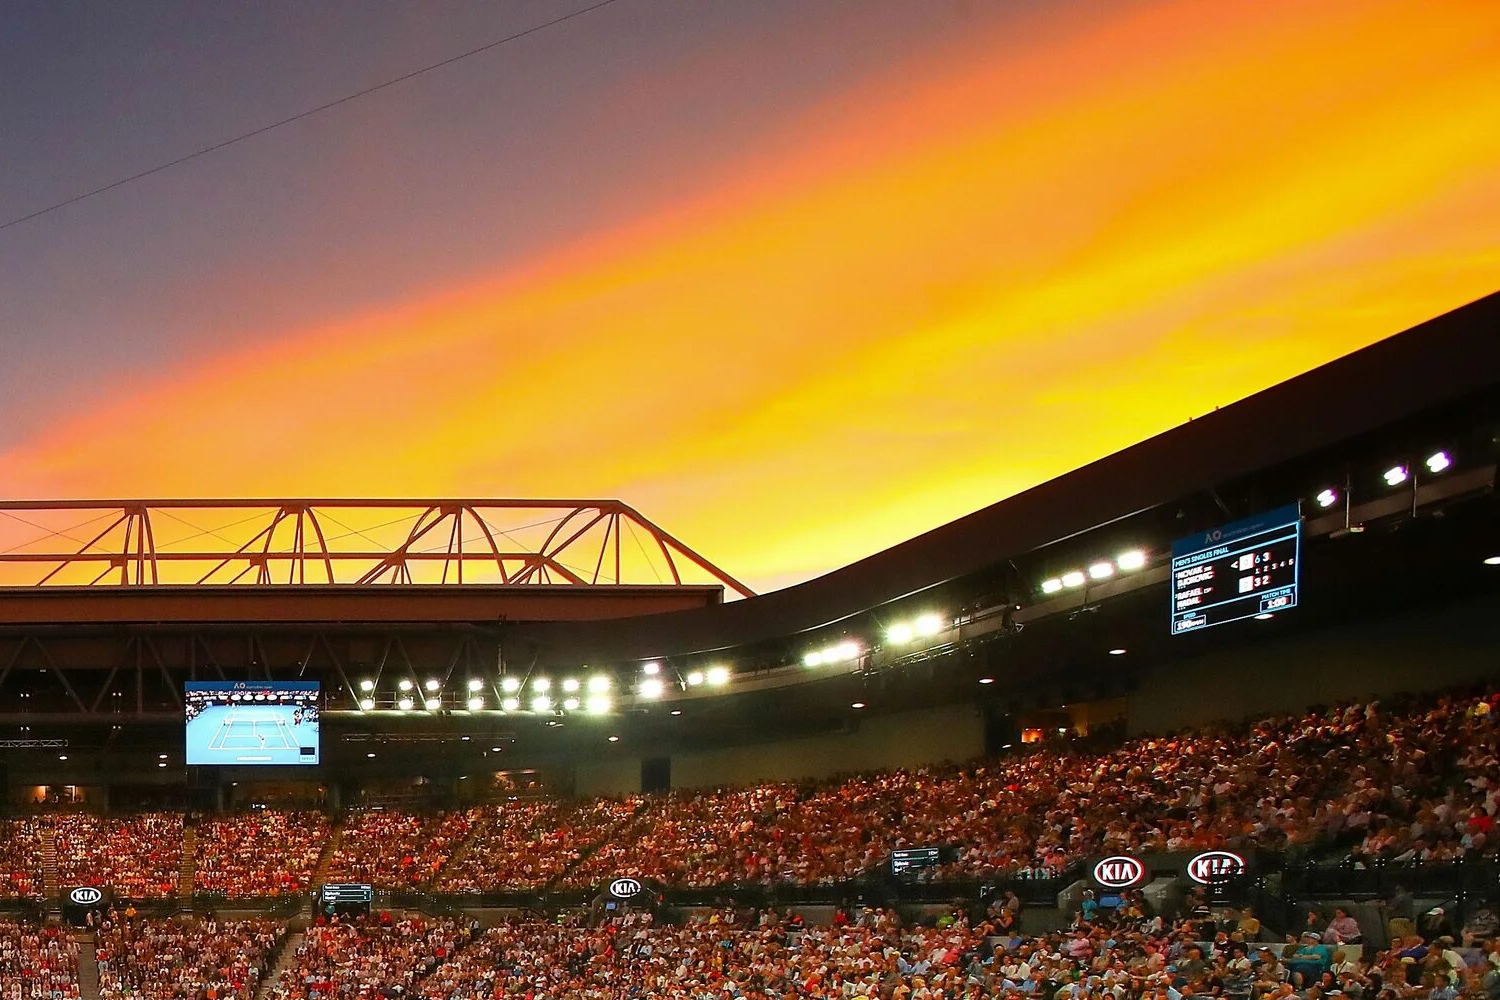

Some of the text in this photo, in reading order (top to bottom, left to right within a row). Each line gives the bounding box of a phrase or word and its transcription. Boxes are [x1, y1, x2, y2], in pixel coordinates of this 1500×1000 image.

[1191, 551, 1213, 562] SINGLES
[1213, 547, 1229, 557] FINAL
[1254, 555, 1261, 564] 6
[1101, 863, 1134, 881] KIA
